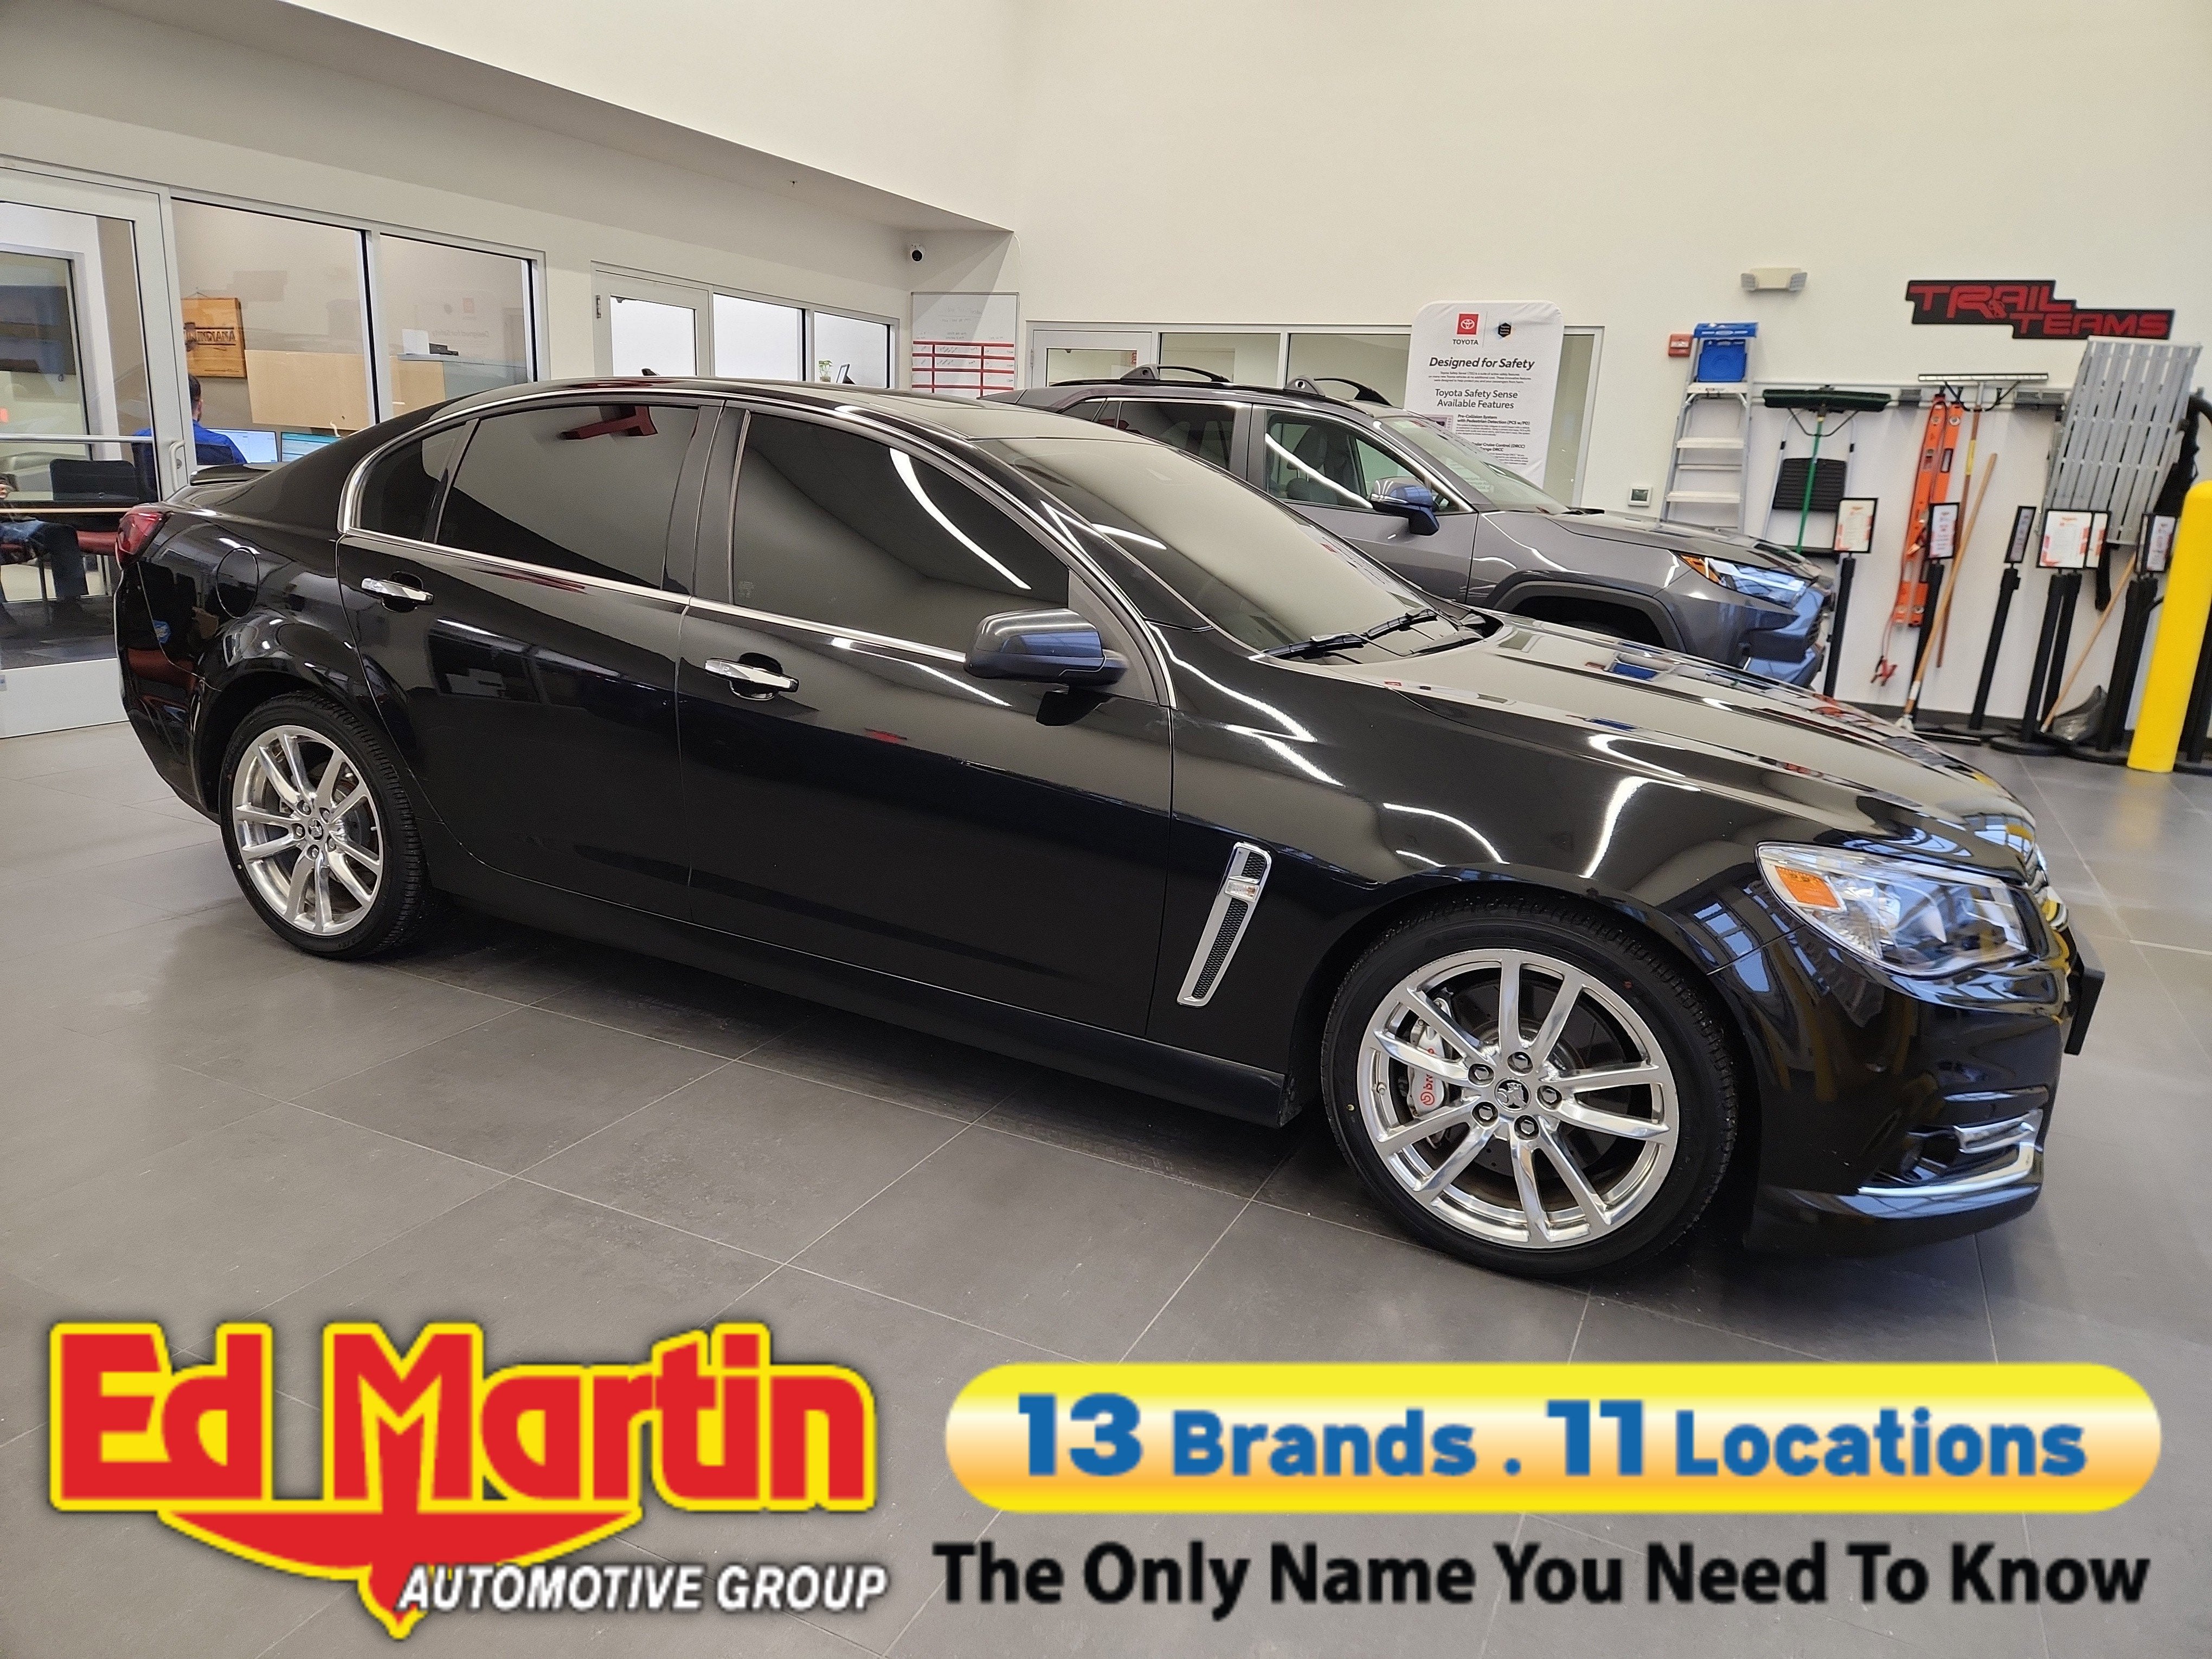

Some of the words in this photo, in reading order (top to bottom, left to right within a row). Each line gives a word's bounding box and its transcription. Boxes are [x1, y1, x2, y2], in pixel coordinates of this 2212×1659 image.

[1909, 285, 2072, 319] TRAIL
[2010, 312, 2168, 337] TEAMS
[196, 330, 236, 342] INDIANA
[1429, 357, 1481, 369] Designed
[1481, 357, 1498, 368] for
[1499, 358, 1535, 371] Safety
[1435, 388, 1463, 398] Toyota
[1464, 389, 1491, 400] Safety
[1492, 390, 1518, 398] Sense
[1437, 399, 1476, 408] Available
[1477, 400, 1514, 409] Features
